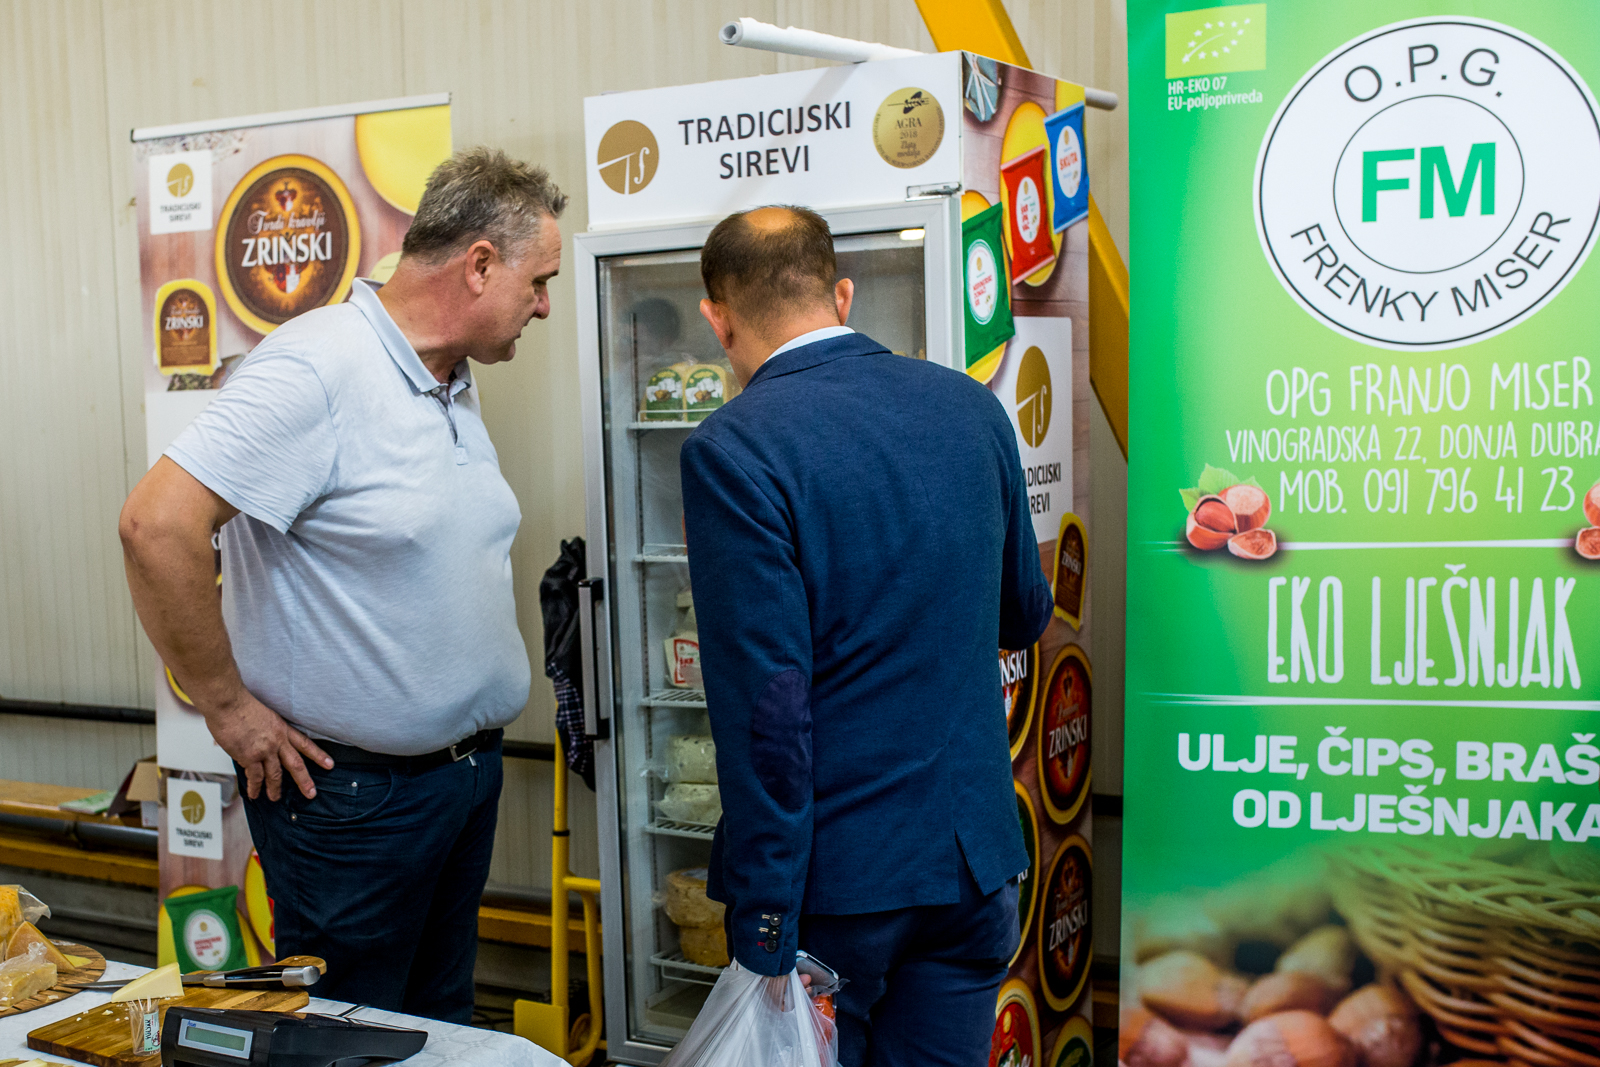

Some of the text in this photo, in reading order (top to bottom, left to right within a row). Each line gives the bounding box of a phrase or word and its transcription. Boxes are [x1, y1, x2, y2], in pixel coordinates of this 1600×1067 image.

[1168, 76, 1227, 96] HR-EKO 07
[1168, 89, 1263, 112] EU-poljoprivreda
[678, 101, 851, 145] TRADICIJSKI
[719, 145, 810, 180] SIREVI
[1362, 142, 1496, 222] FM
[241, 231, 332, 267] ZRINSKI
[1290, 211, 1571, 322] FRENKY MISER
[1266, 356, 1593, 418] OPG FRANJO MISER
[1226, 424, 1381, 463] VINOGRADSKA
[1394, 426, 1427, 464] 22,
[1440, 422, 1518, 460] DONJA
[1022, 462, 1061, 487] DICIJSKI
[1280, 466, 1575, 515] MOB. 091 796 41 23
[1028, 492, 1050, 514] REVI
[1267, 563, 1581, 689] EKO LJEŠNJAK
[999, 649, 1027, 687] NSKI
[1049, 714, 1087, 759] ZRINSKI
[1178, 733, 1309, 780] ULJE,
[1317, 726, 1446, 785] ČIPS,
[1232, 789, 1301, 829] OD
[1049, 900, 1087, 952] ZRINSKI
